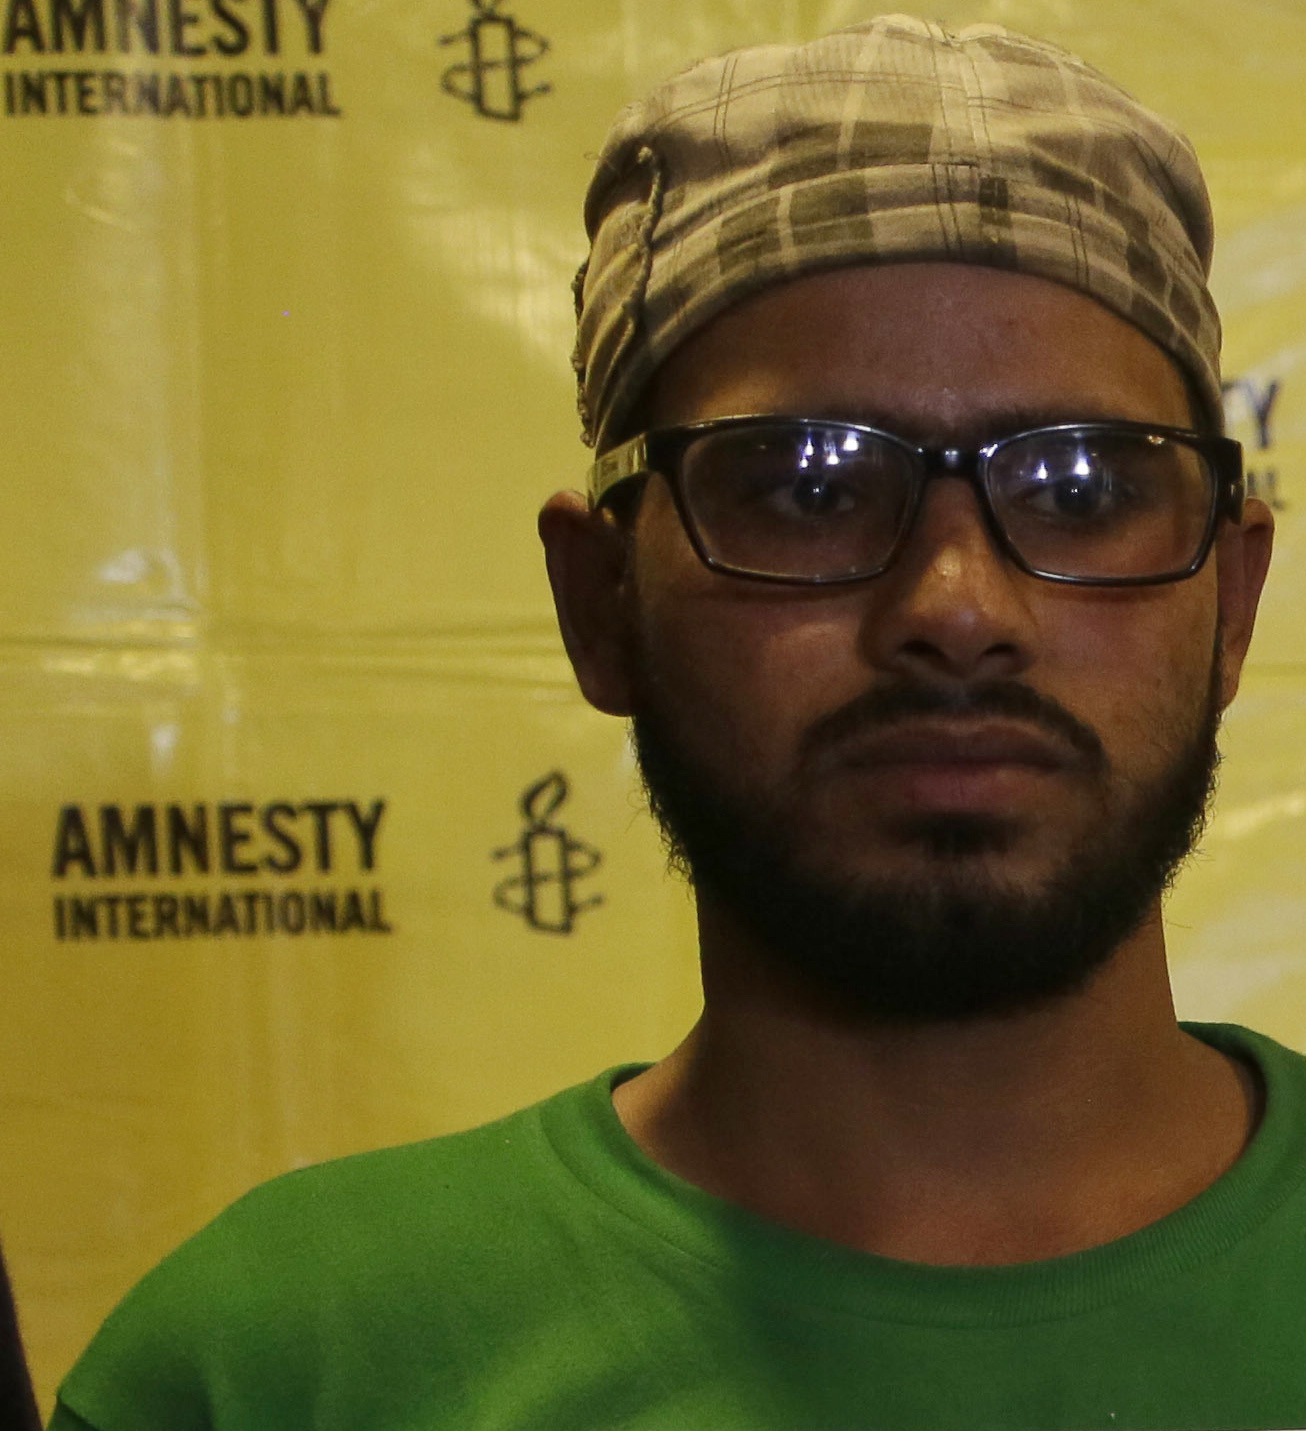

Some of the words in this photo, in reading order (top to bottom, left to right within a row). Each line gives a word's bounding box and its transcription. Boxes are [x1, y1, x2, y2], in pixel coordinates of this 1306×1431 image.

[3, 0, 329, 53] AMNESTY
[4, 69, 342, 117] INTERNATIONAL
[53, 800, 385, 877] AMNESTY
[54, 889, 393, 941] INTERNATIONAL
